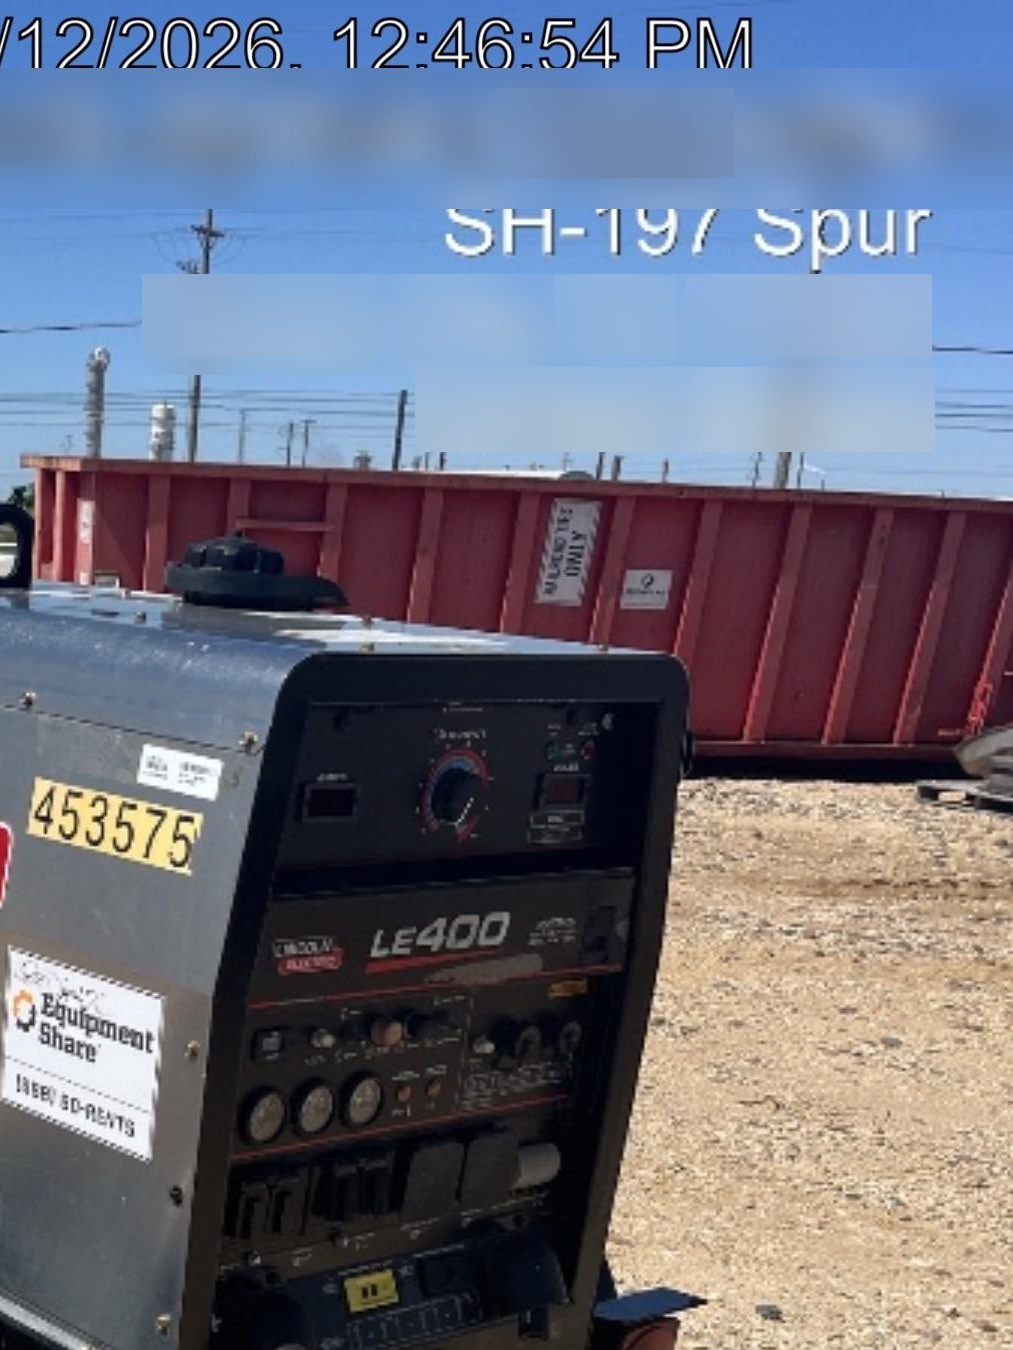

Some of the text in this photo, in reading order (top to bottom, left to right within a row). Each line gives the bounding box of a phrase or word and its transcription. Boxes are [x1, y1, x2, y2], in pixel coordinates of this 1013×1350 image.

[33, 786, 197, 868] 453575
[370, 911, 511, 958] LE400
[39, 1022, 97, 1064] Share
[40, 992, 155, 1054] Equipment
